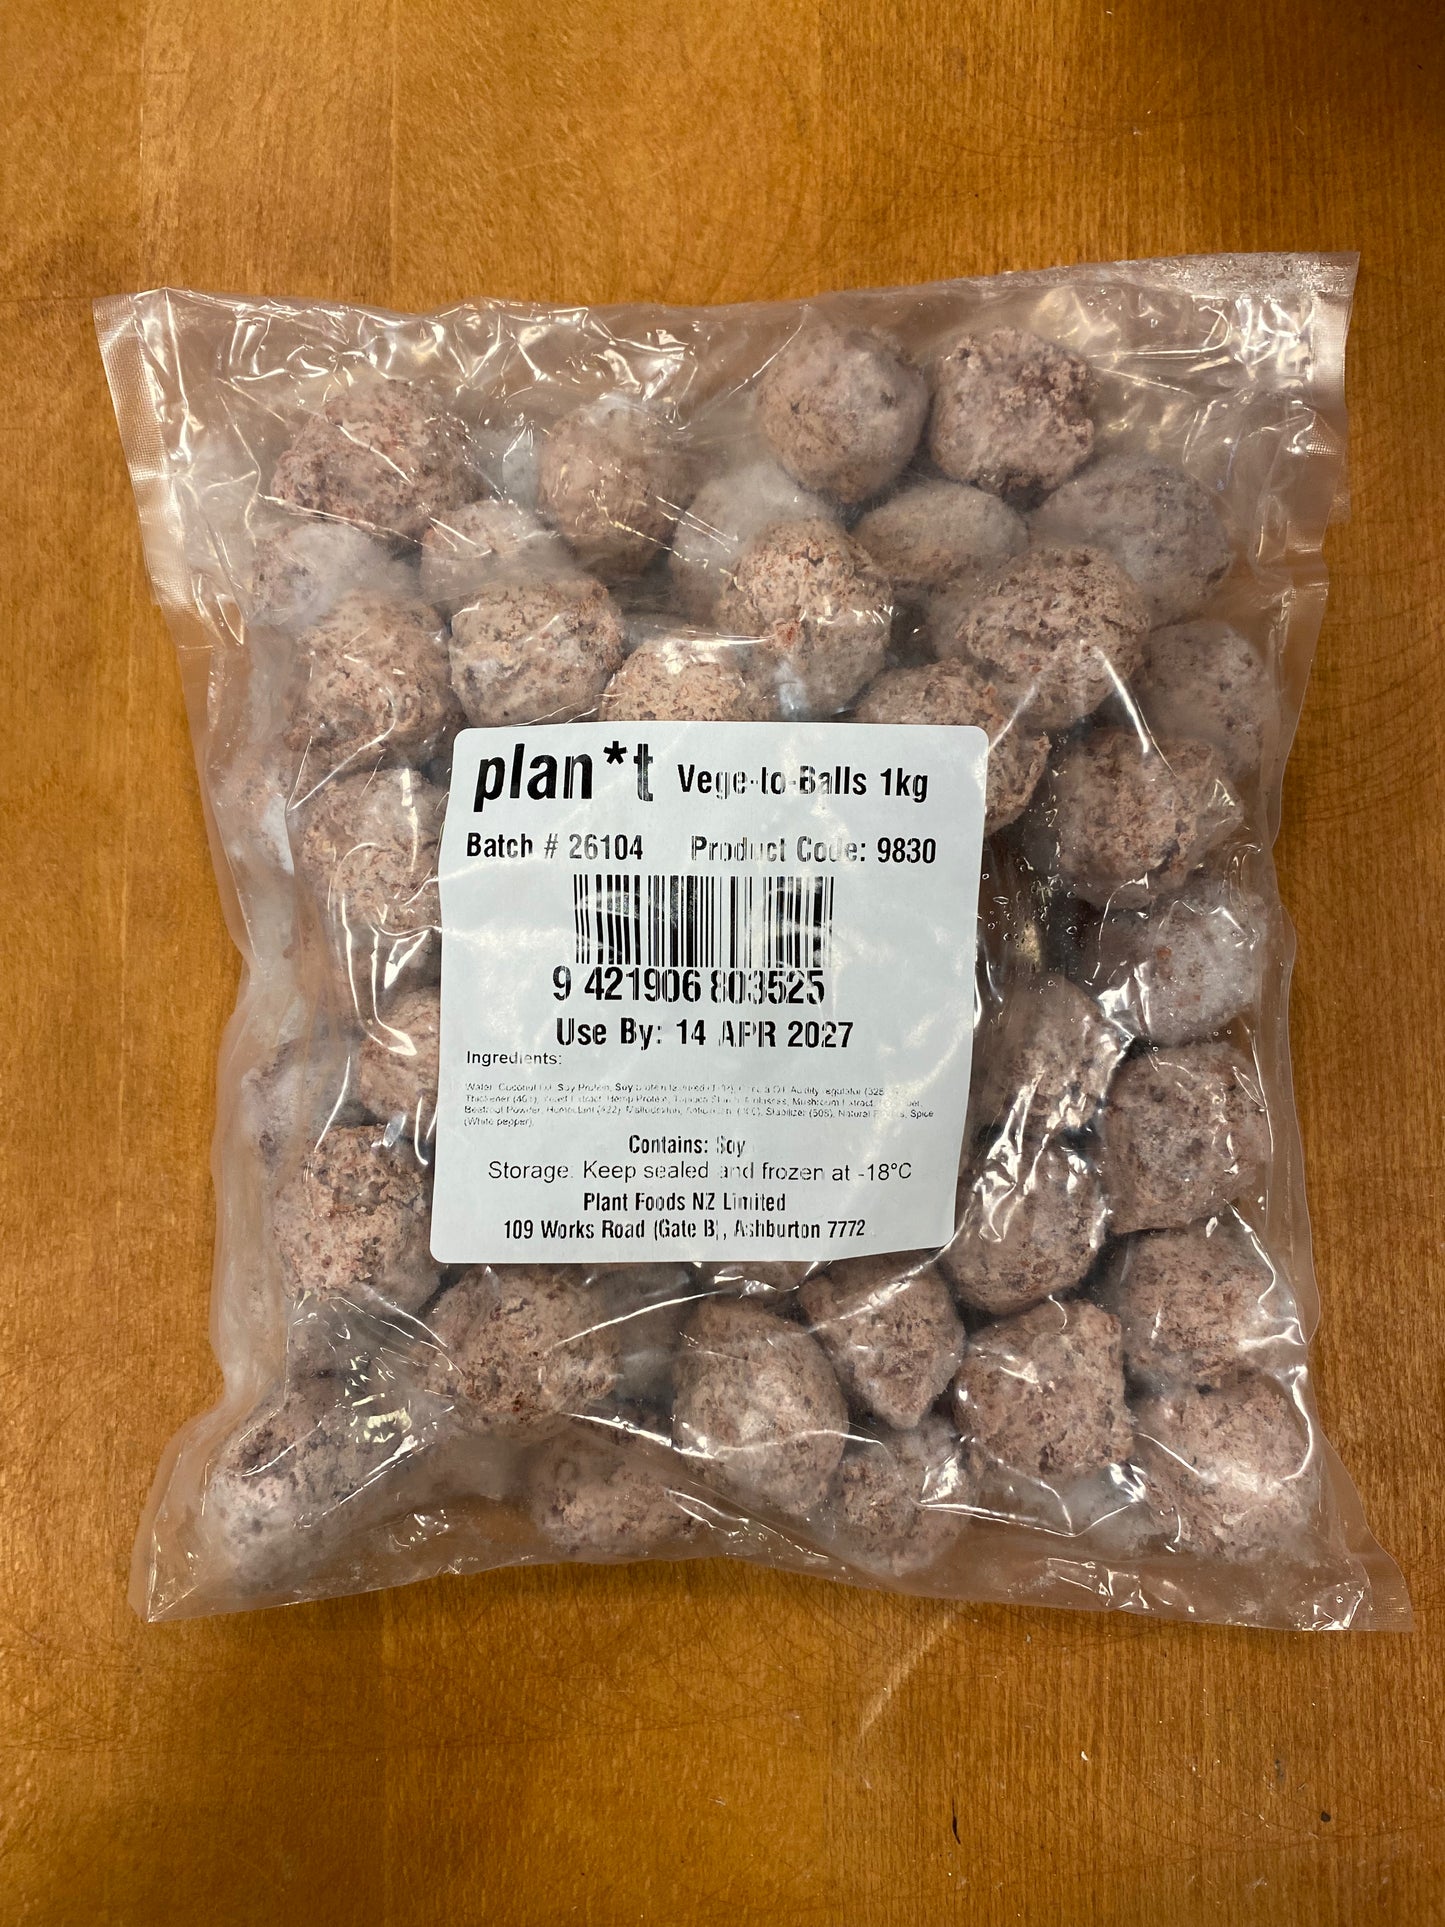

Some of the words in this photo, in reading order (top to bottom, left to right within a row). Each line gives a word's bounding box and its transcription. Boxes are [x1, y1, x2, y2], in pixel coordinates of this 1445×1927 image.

[880, 767, 928, 803] 1kg
[466, 832, 533, 859] Batch
[544, 833, 559, 859] #
[569, 834, 643, 860] 26104
[691, 835, 785, 862] Product
[796, 836, 866, 863] Code:
[877, 837, 936, 864] 9830
[552, 965, 572, 1001] 9
[584, 966, 701, 1003] 421906
[710, 969, 825, 1005] 803525
[556, 1017, 607, 1046] Use
[620, 1017, 663, 1050] By:
[676, 1019, 706, 1045] 14
[718, 1020, 776, 1048] APR
[787, 1021, 854, 1048] 2027
[466, 1051, 563, 1066] Ingredients:
[615, 1083, 634, 1094] Soy
[629, 1135, 708, 1154] Contains:
[716, 1136, 745, 1157] Soy
[583, 1161, 636, 1183] Keep
[643, 1161, 708, 1179] sealed
[718, 1162, 754, 1179] and
[762, 1162, 824, 1181] frozen
[831, 1164, 850, 1181] at
[858, 1162, 912, 1181] -18°C
[583, 1192, 628, 1211] Plant
[635, 1192, 686, 1211] Foods
[692, 1192, 715, 1211] NZ
[723, 1192, 786, 1211] Limited
[504, 1219, 534, 1239] 109
[541, 1219, 594, 1239] Works
[601, 1219, 645, 1239] Road
[653, 1218, 697, 1241] (Gate
[733, 1219, 820, 1240] Ashburton
[827, 1219, 866, 1239] 7772
